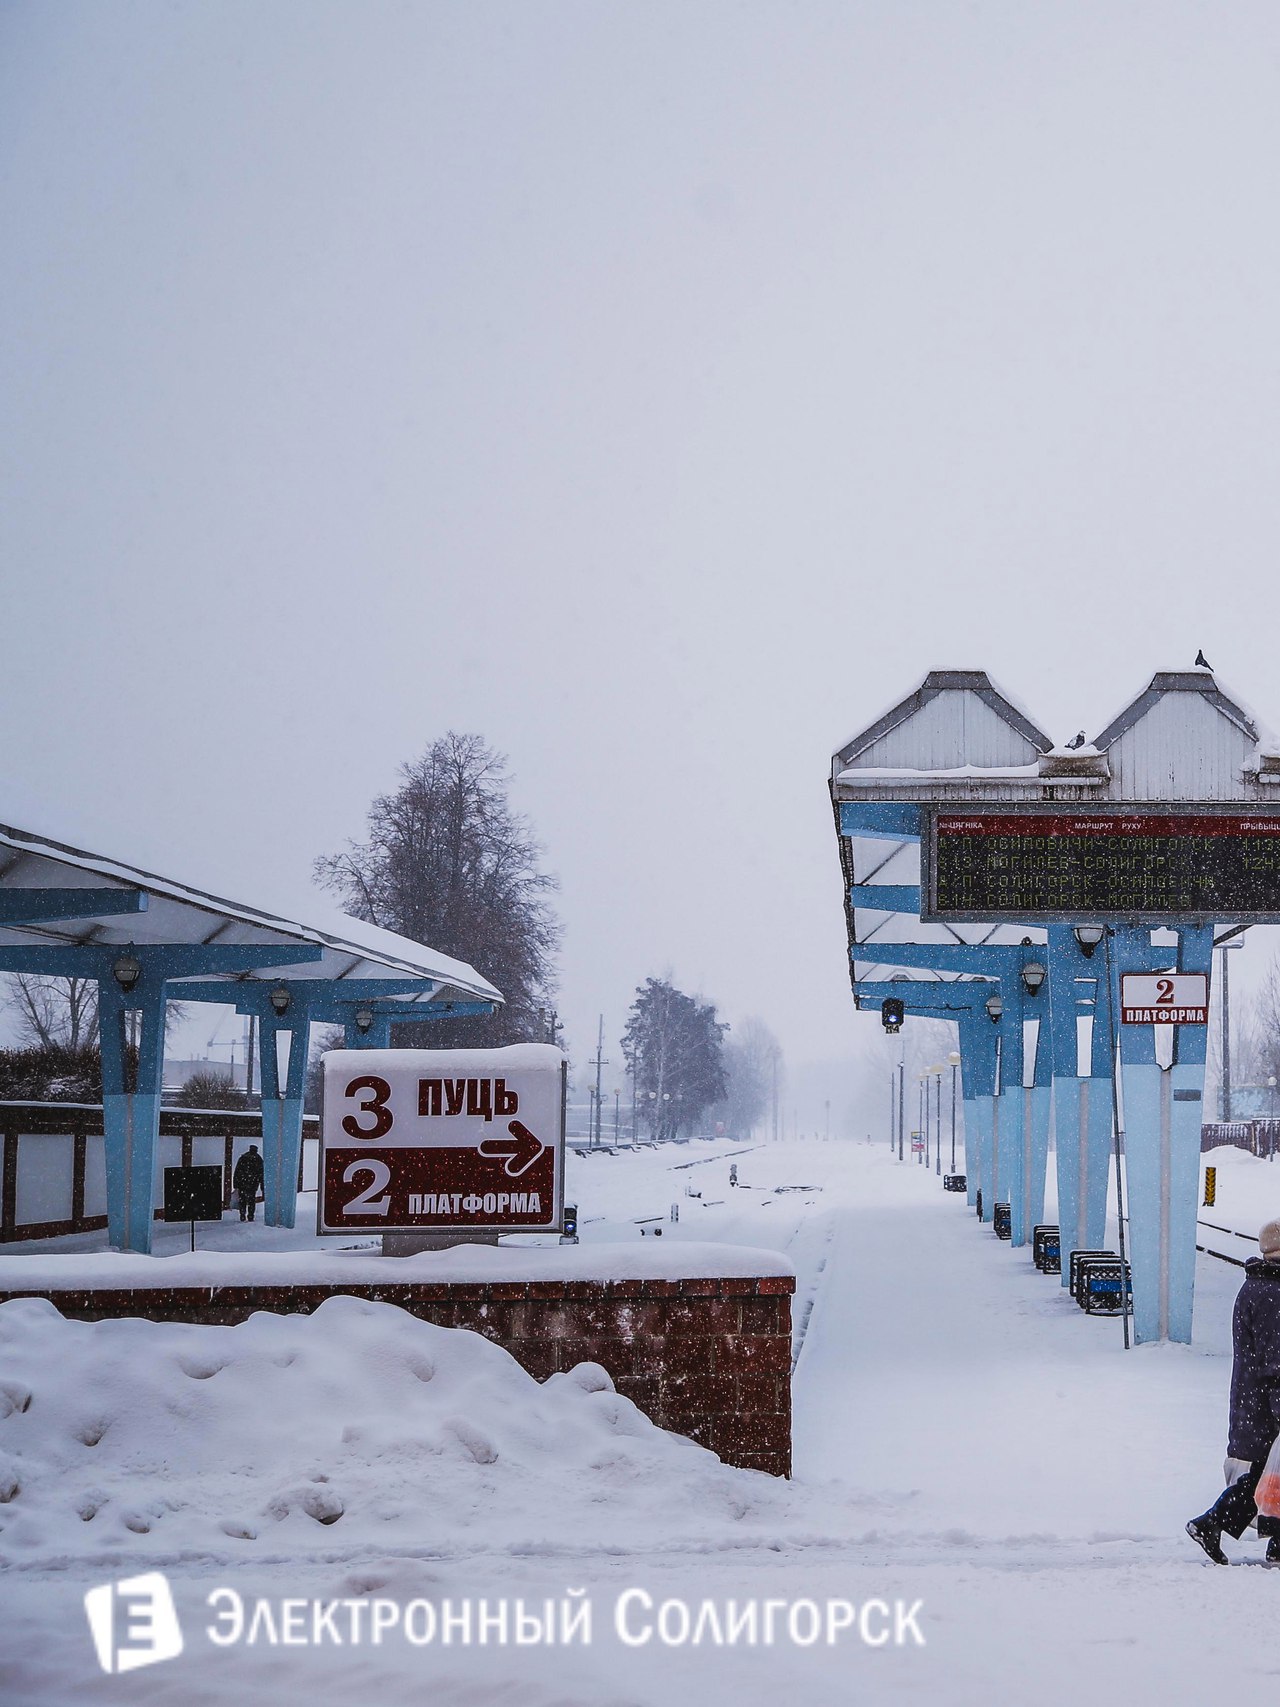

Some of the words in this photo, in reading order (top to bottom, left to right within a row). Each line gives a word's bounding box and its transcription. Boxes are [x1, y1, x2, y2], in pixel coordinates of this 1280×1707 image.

[1074, 821, 1114, 830] МАРШРУТ
[1121, 822, 1142, 830] РУХУ
[1156, 979, 1175, 1005] 2
[1126, 1009, 1205, 1022] ПЛАТФОРМА
[341, 1075, 394, 1140] 3
[417, 1078, 519, 1122] ПУЦЬ
[342, 1158, 391, 1216] 2
[408, 1192, 542, 1214] ПЛАТФОРМА
